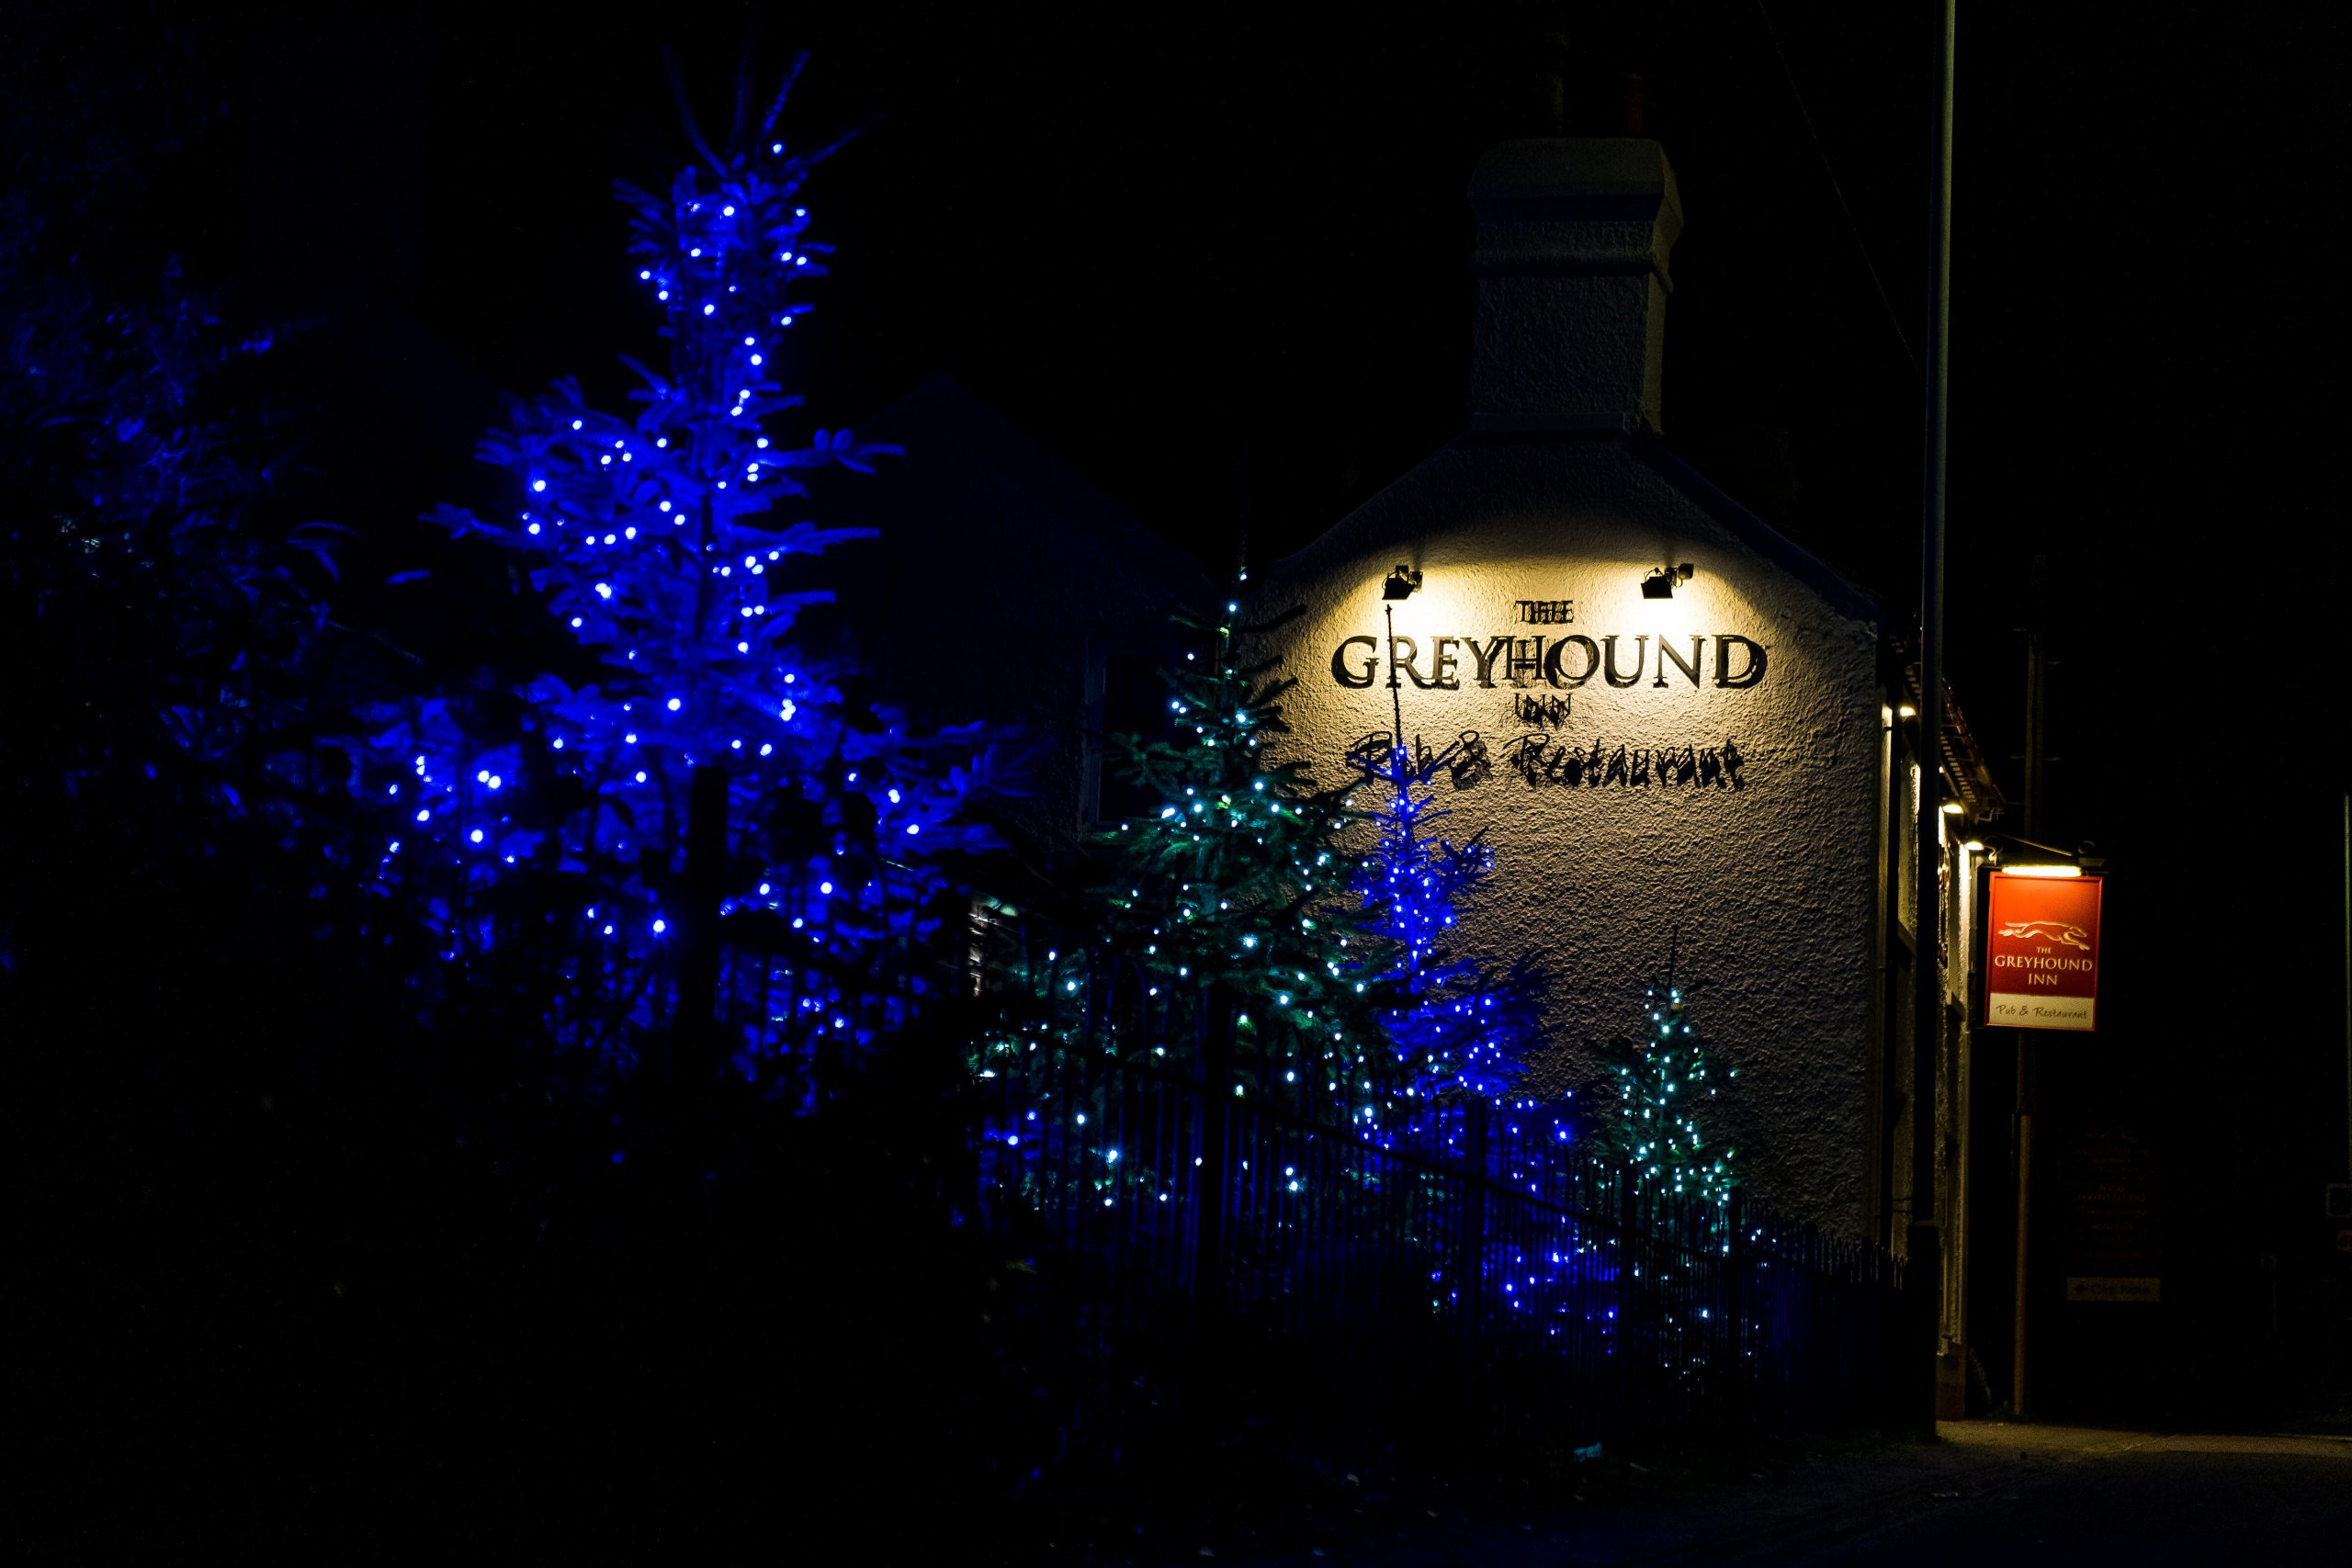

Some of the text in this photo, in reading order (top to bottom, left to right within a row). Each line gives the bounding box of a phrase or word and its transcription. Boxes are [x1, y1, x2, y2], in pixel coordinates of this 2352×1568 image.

[1514, 599, 1574, 625] THE
[1331, 633, 1768, 689] GREYHOUND
[1514, 693, 1572, 724] INN
[1502, 732, 1745, 788] Restaurant
[2037, 946, 2052, 954] THE
[1995, 954, 2094, 972] GREYHOUND
[2028, 973, 2059, 986] INN
[1996, 1004, 2088, 1020] Pub & Restaurant
